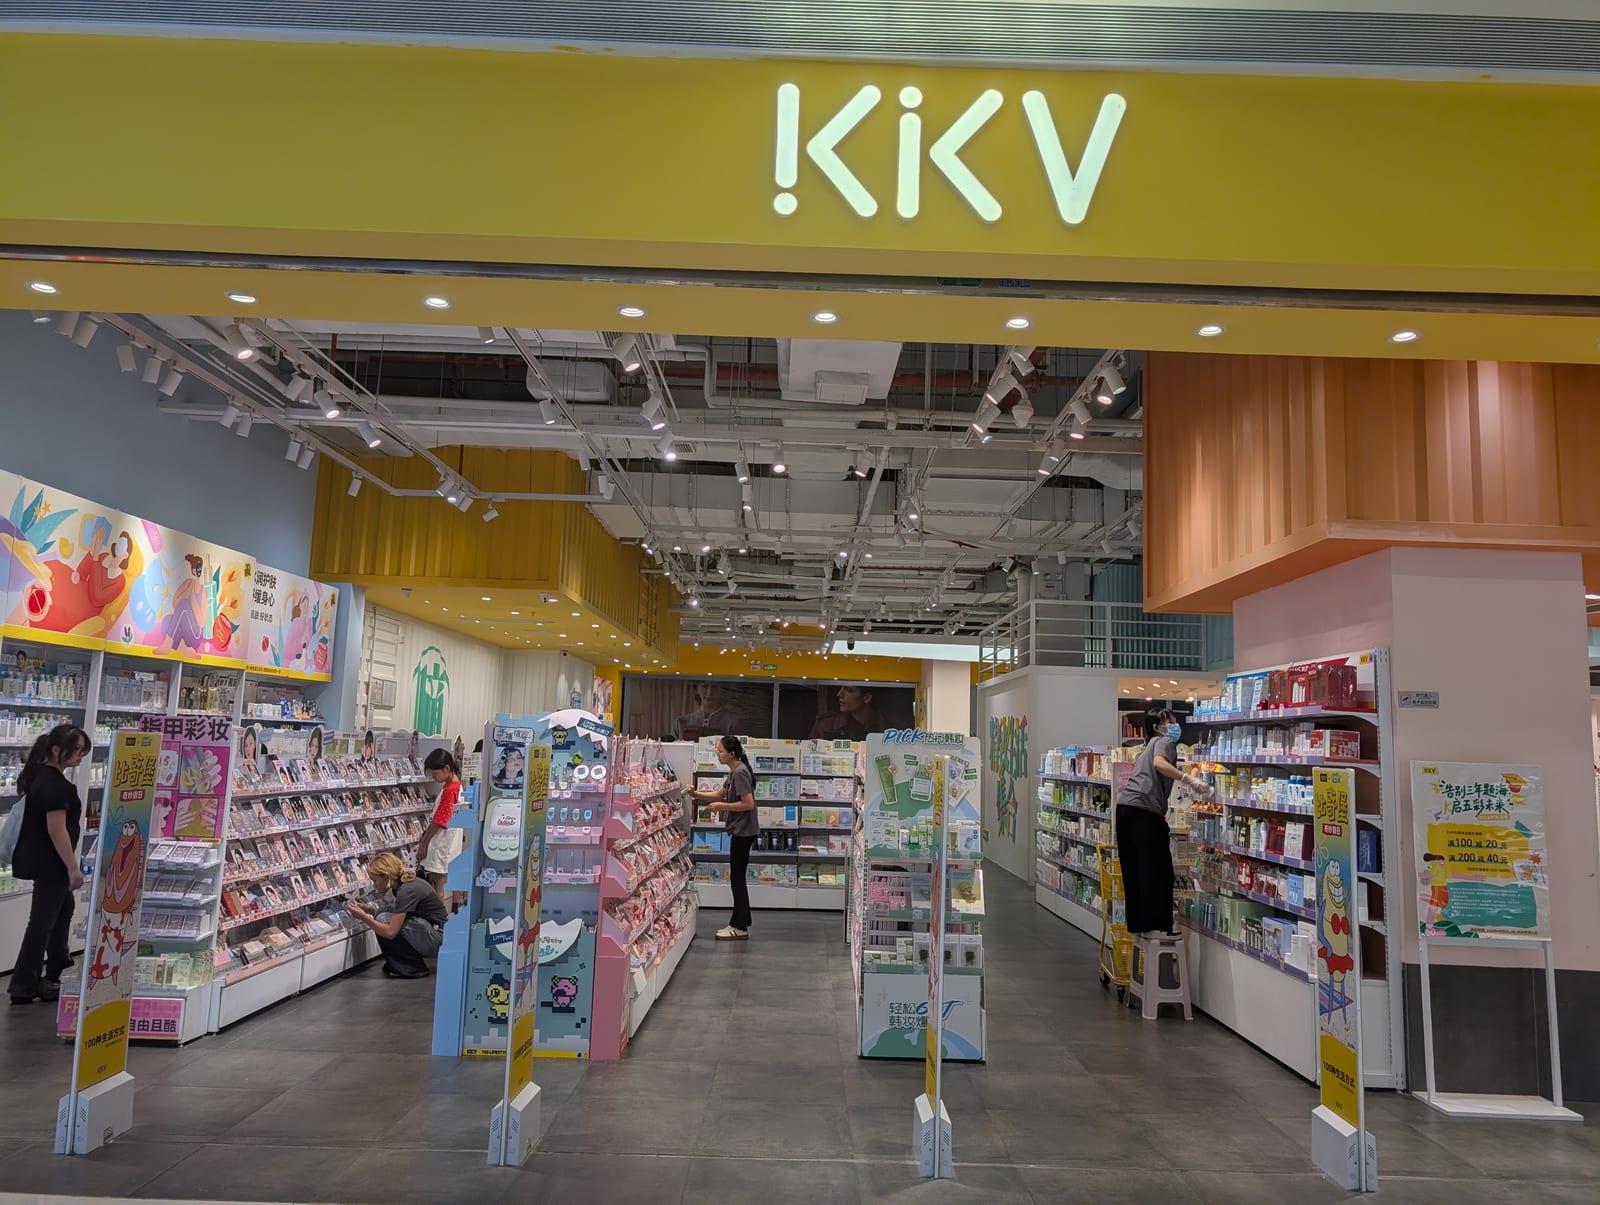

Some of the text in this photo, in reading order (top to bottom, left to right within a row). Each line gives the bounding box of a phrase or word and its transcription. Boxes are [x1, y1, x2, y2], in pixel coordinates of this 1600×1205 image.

[141, 717, 231, 741] 指甲彩妆
[883, 729, 924, 744] PICK
